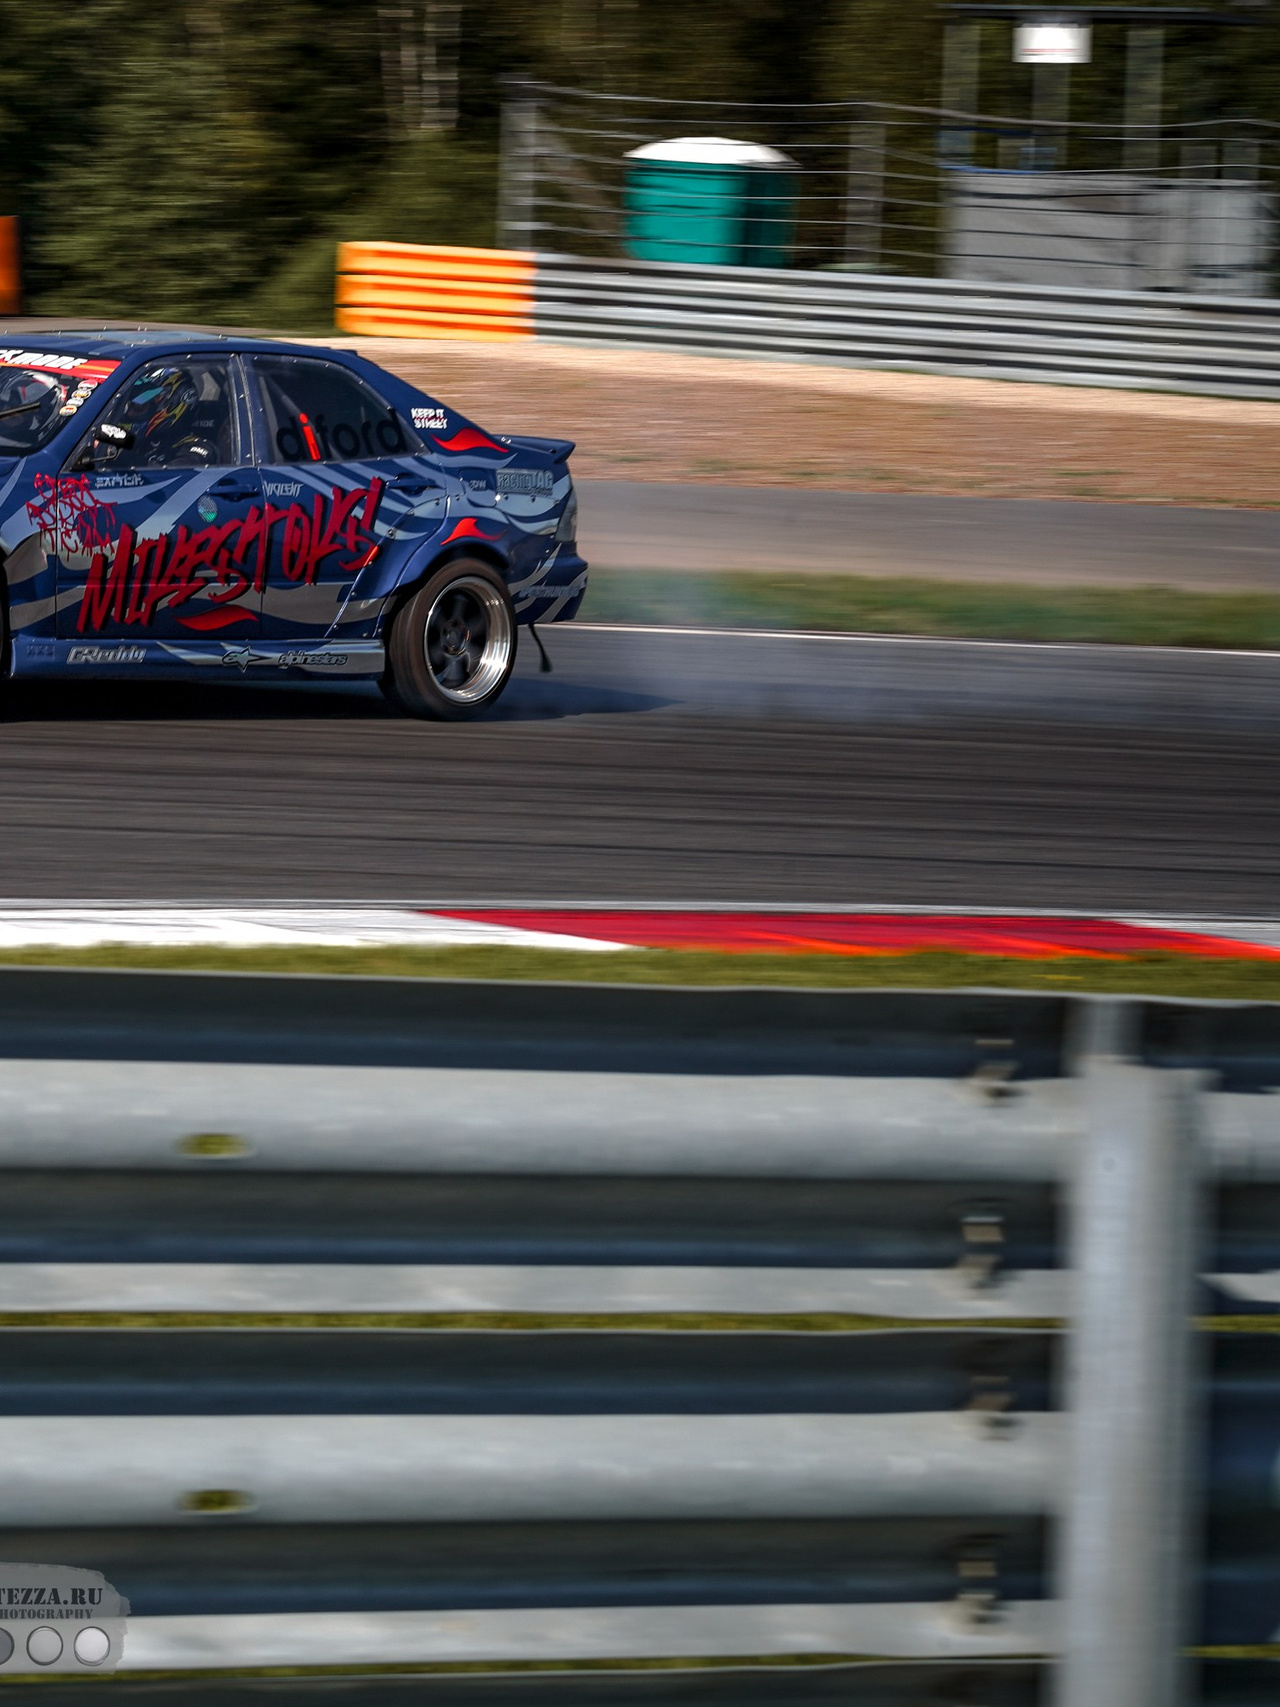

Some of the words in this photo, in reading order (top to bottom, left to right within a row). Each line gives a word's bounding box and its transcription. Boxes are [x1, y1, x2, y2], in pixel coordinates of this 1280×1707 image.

[411, 407, 436, 419] KEEP
[276, 405, 409, 462] diford
[66, 645, 147, 665] GReddy
[278, 650, 348, 667] alpinestars
